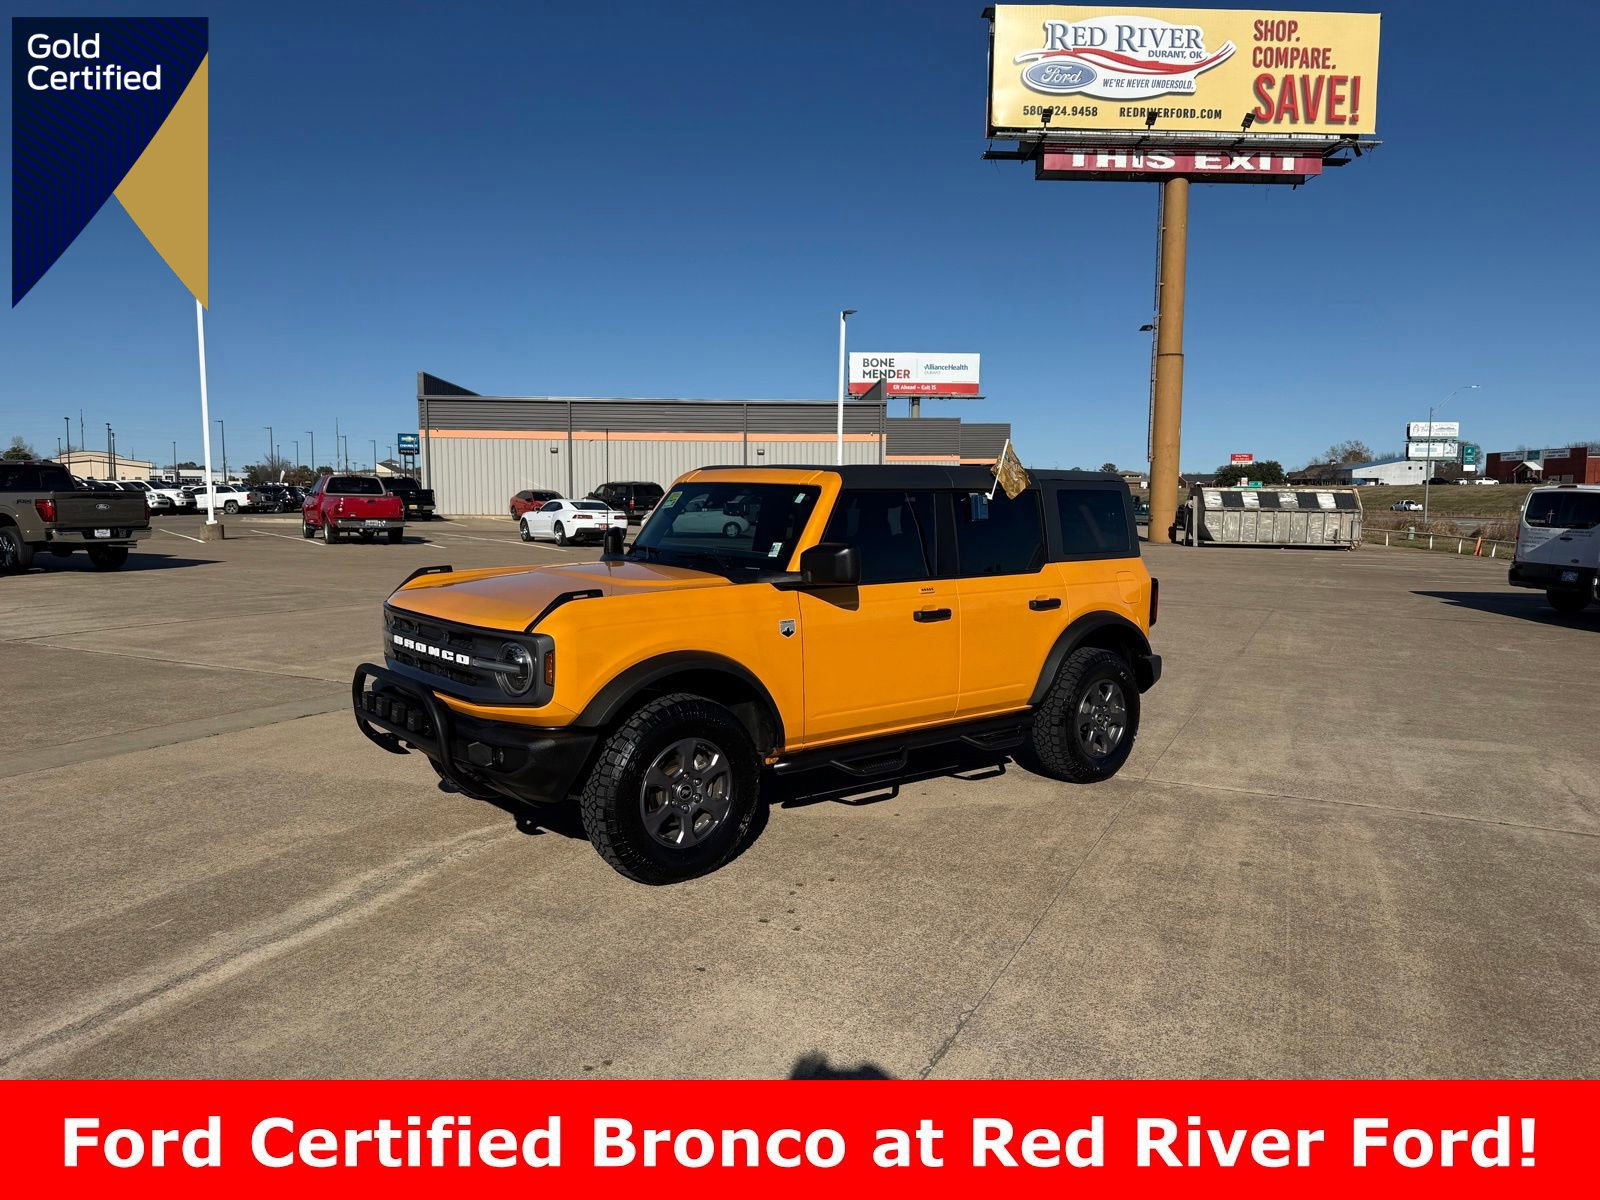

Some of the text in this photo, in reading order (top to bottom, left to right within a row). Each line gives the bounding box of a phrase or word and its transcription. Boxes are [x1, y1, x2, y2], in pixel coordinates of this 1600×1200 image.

[1047, 23, 1203, 52] RED RIVER
[1253, 19, 1300, 42] SHOP.
[1148, 50, 1203, 59] DURANT, OK
[1252, 46, 1336, 69] COMPARE.
[1040, 65, 1082, 83] Ford
[1102, 78, 1194, 90] WE'RE NEVER UNDERSOLD.
[1252, 73, 1361, 125] SAVE!
[1023, 105, 1098, 117] 58024.9458
[1065, 149, 1303, 171] THIS EXIT
[862, 358, 895, 368] BONE
[924, 363, 969, 371] AllianceHealth
[862, 369, 911, 379] MENDER
[393, 634, 470, 666] BRONCO
